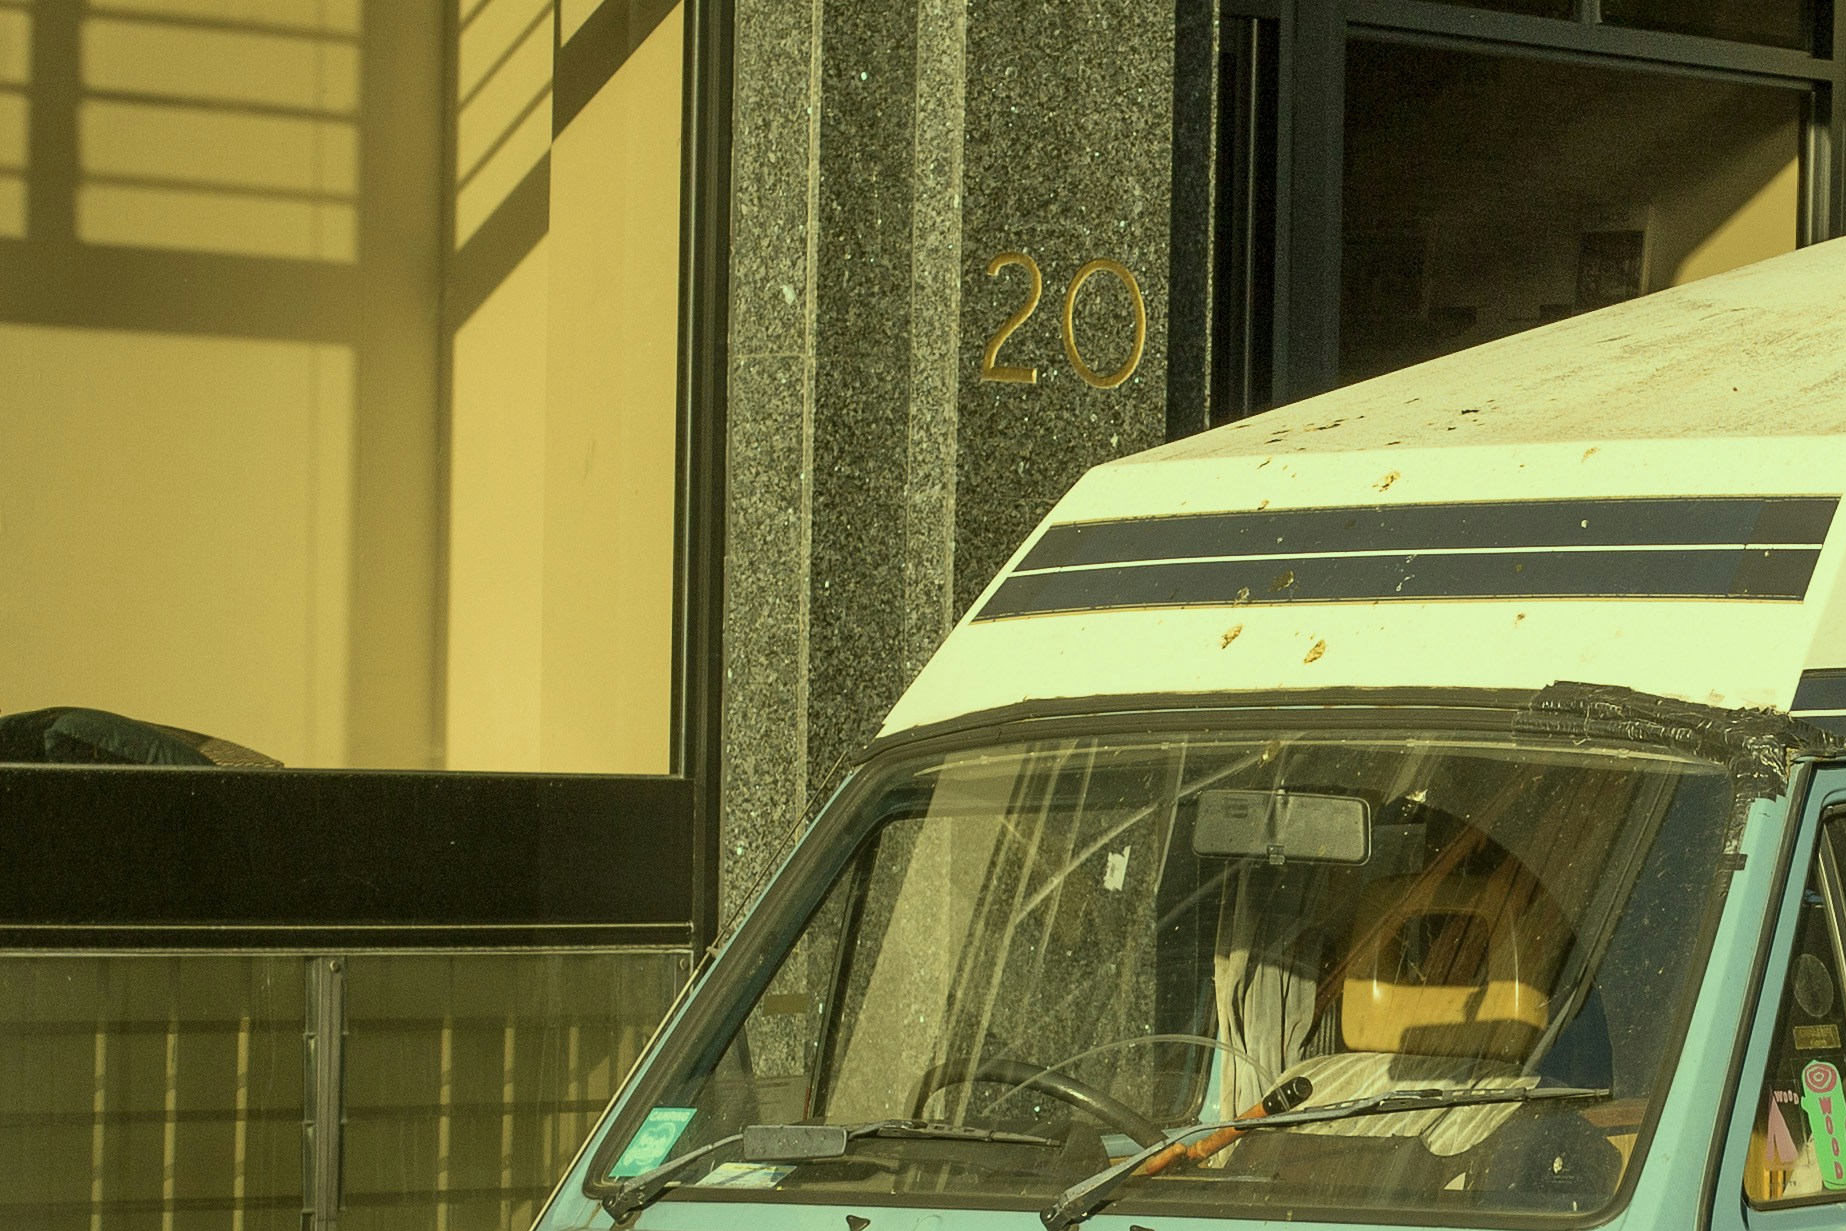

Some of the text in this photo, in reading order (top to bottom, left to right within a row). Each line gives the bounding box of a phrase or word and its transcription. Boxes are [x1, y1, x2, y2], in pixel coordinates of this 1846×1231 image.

[981, 251, 1147, 390] 20
[1773, 1089, 1800, 1105] WOOD
[1818, 1096, 1844, 1180] WOOD
